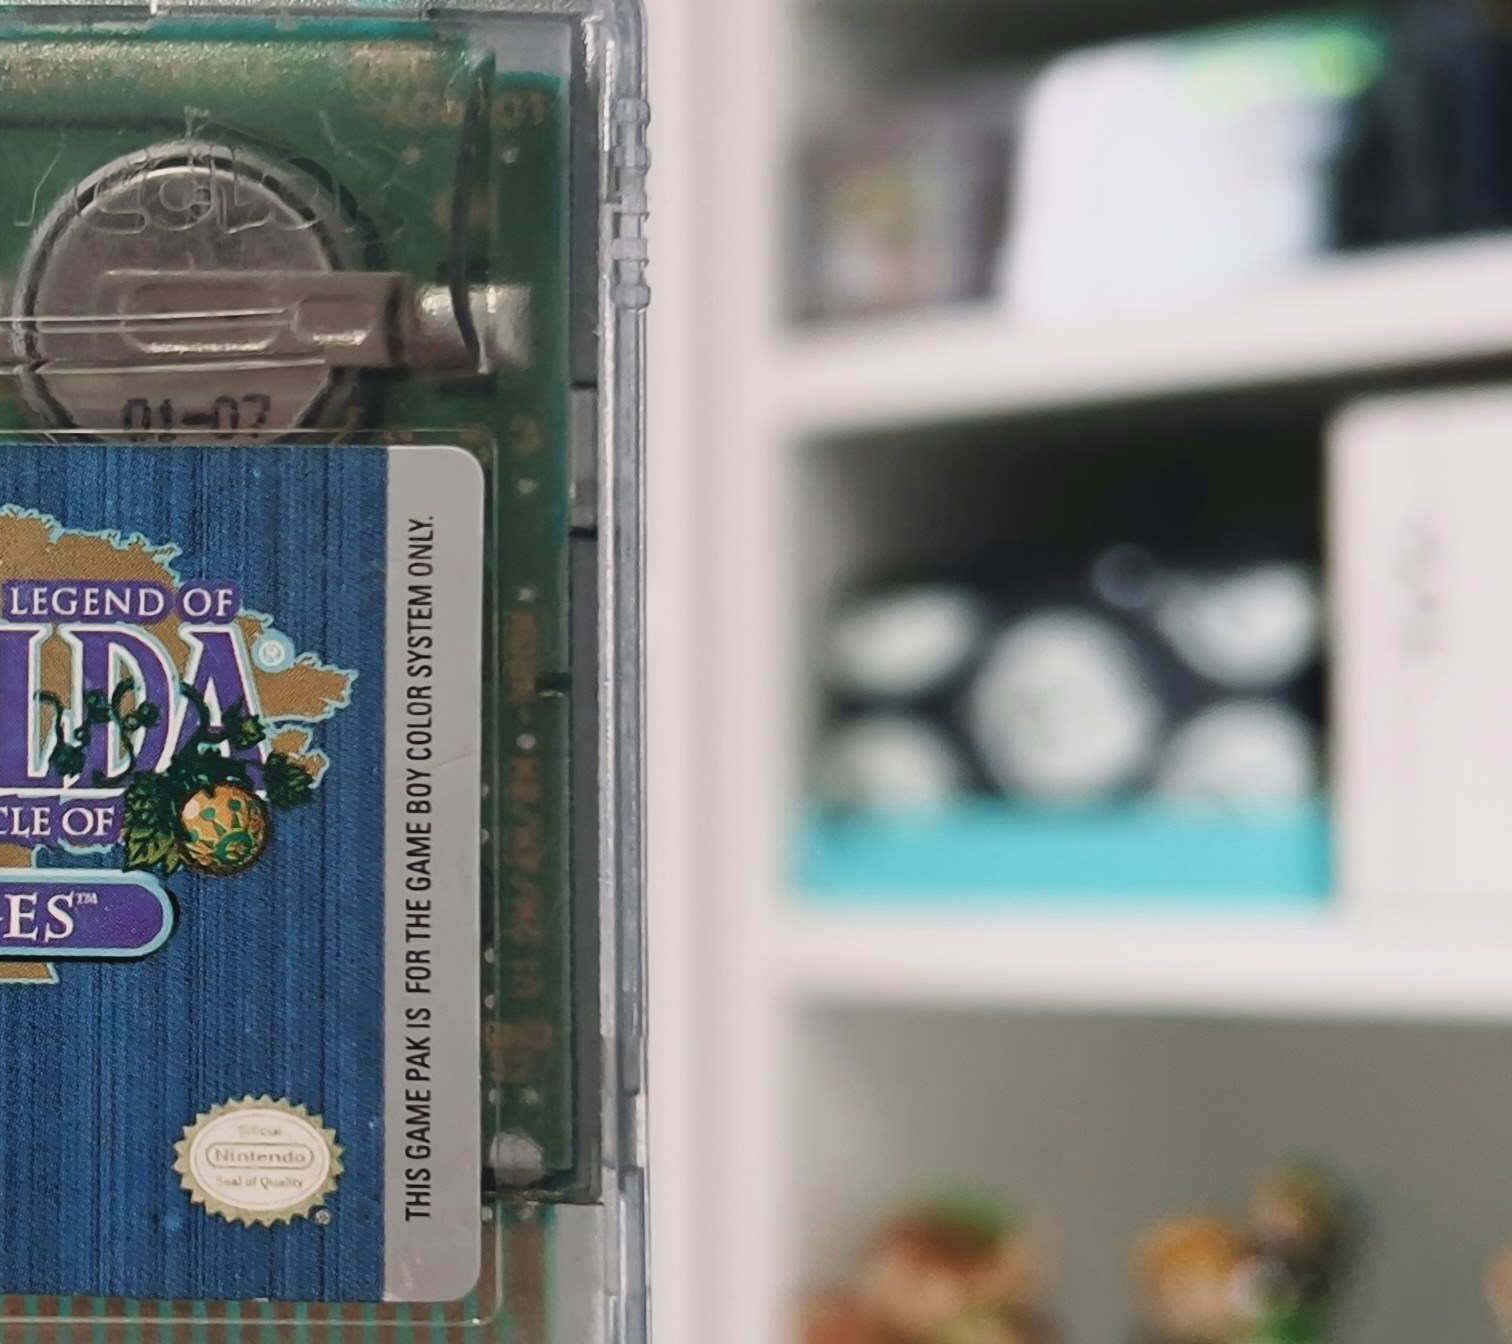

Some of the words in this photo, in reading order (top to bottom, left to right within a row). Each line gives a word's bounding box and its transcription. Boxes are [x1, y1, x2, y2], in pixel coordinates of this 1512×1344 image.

[408, 515, 434, 577] ONLY.
[10, 587, 166, 616] LEGEND
[182, 588, 234, 617] OF
[407, 584, 433, 678] SYSTEM
[406, 685, 433, 761] COLOR
[406, 767, 433, 814] BOY
[59, 805, 115, 837] OF
[406, 821, 432, 892] GAME
[405, 898, 432, 943] THE
[405, 949, 432, 994] FOR
[405, 1007, 432, 1028] IS
[405, 1035, 432, 1082] PAK
[405, 1088, 432, 1160] GAME
[214, 1148, 306, 1164] Nintendo
[215, 1175, 242, 1187] Seal
[245, 1175, 258, 1187] of
[260, 1175, 303, 1190] Quality
[405, 1167, 432, 1222] THIS
